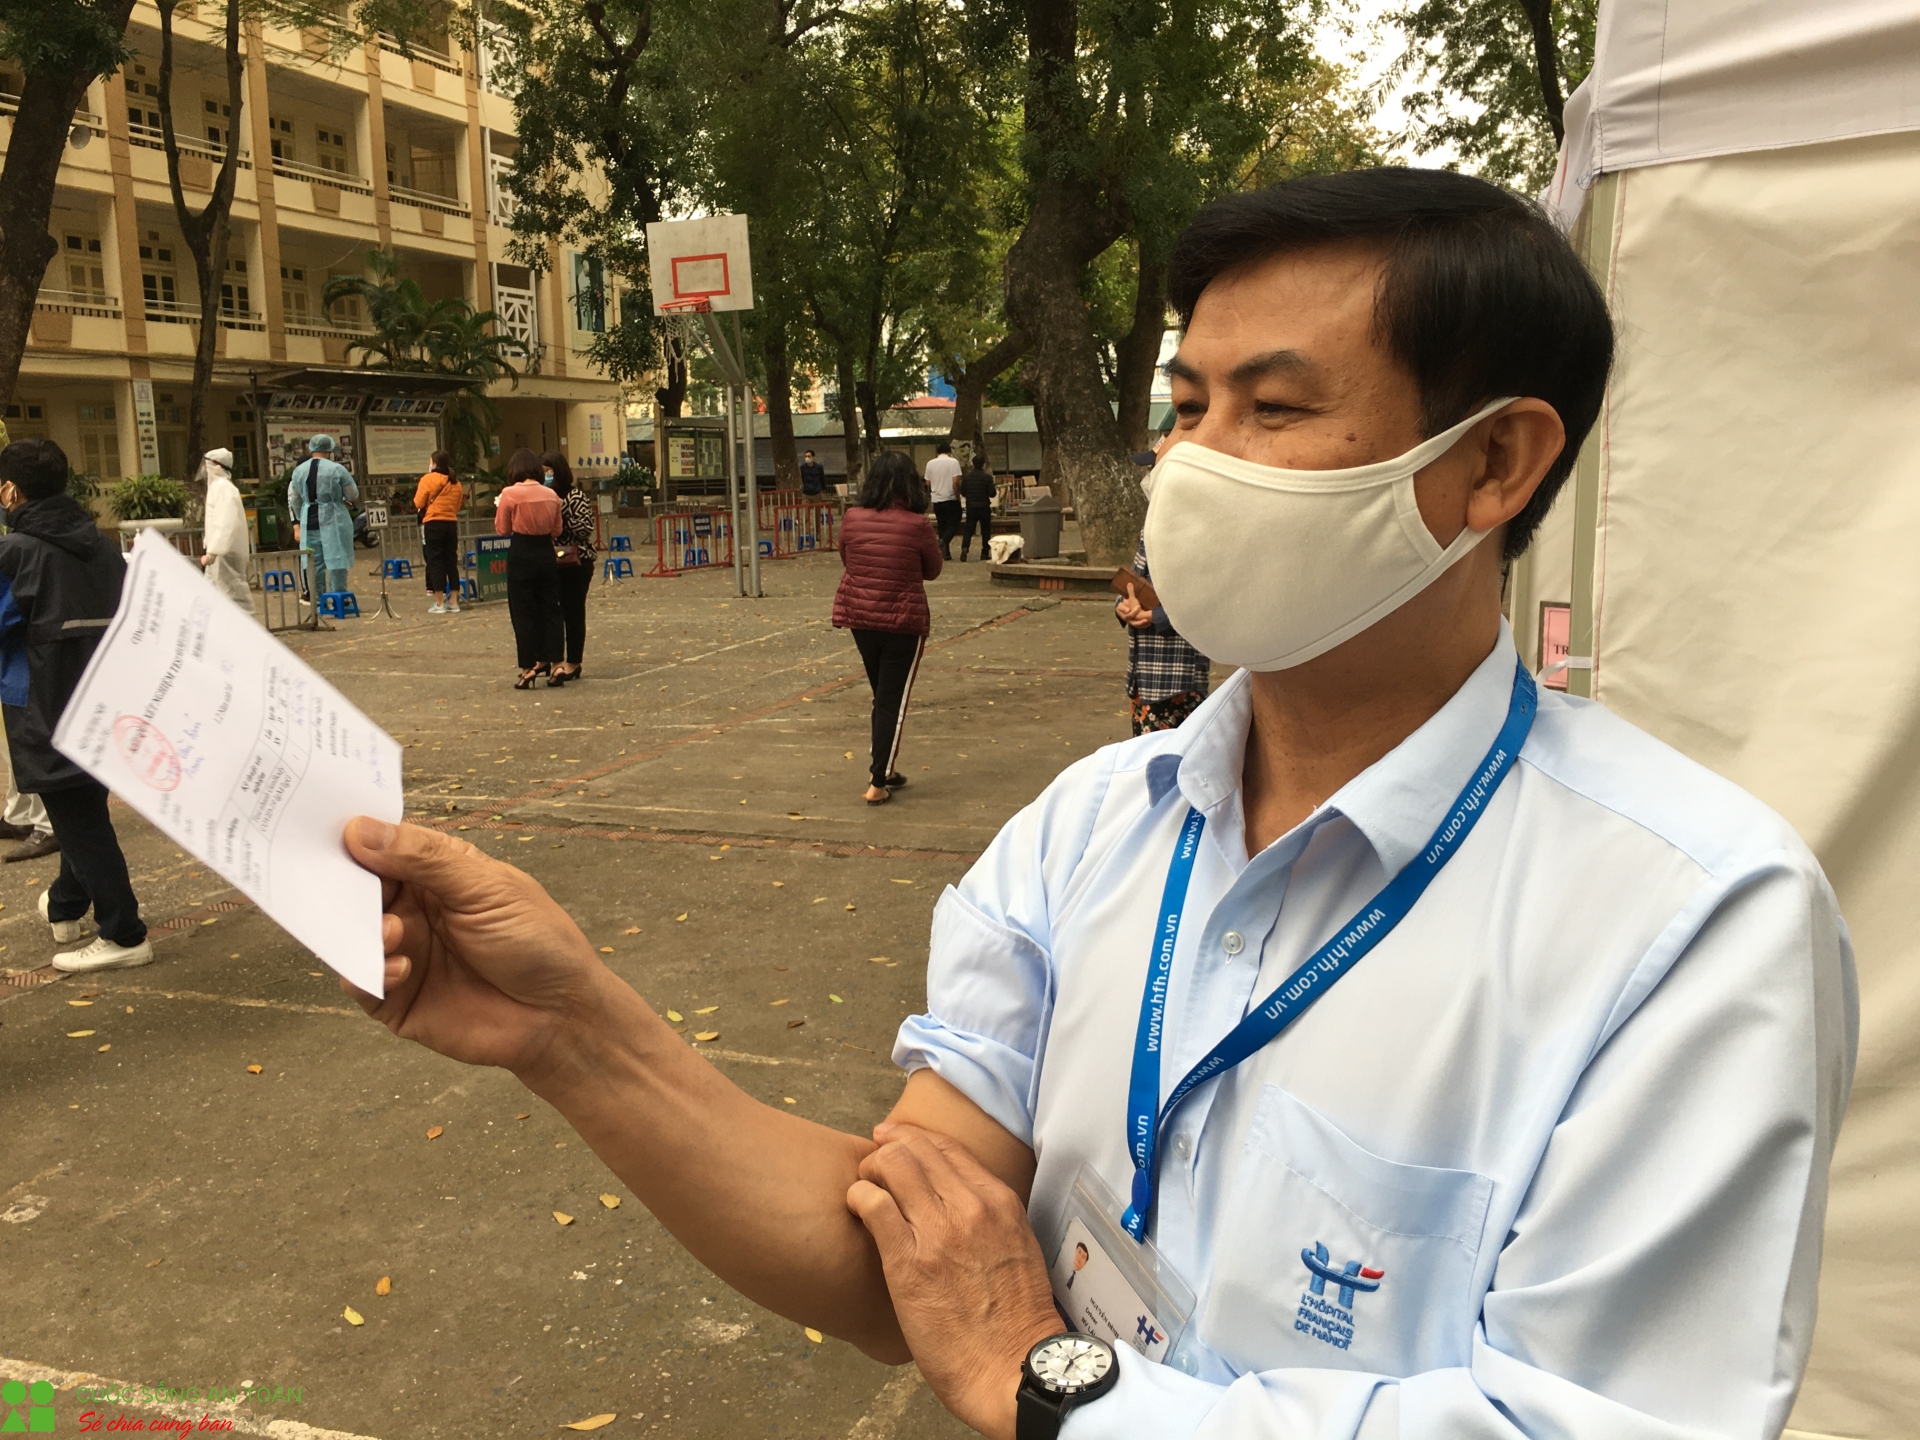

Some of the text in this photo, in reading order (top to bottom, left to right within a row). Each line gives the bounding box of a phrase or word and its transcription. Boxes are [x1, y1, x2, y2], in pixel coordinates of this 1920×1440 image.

[369, 511, 387, 524] 7A2
[1426, 749, 1508, 864] www.hfh.com.vn
[1147, 913, 1178, 1052] www.hfh.com.vn
[1265, 908, 1387, 1020] www.hfh.com.vn
[1294, 1319, 1311, 1334] DE
[1297, 1306, 1354, 1339] FRANÇAIS
